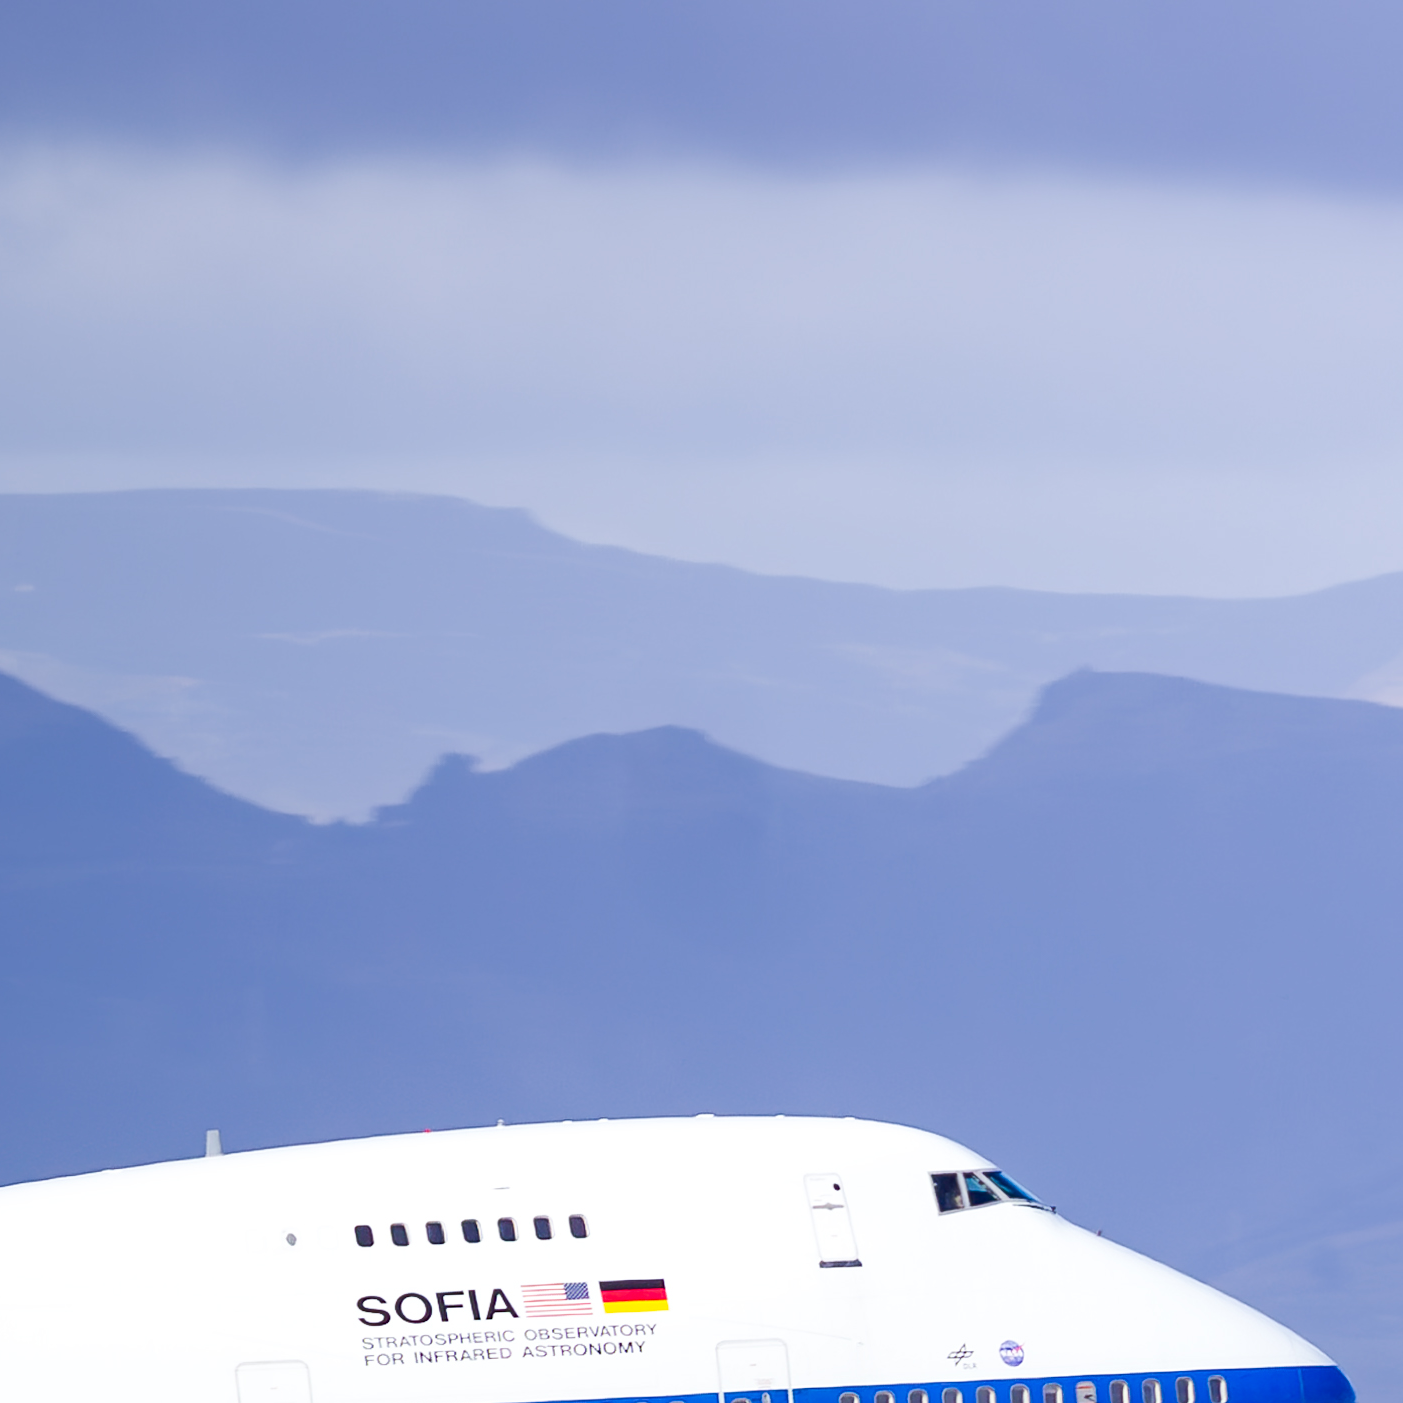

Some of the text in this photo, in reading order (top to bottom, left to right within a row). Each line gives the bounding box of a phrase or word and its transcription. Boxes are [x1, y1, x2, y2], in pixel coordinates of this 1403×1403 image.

[356, 1288, 520, 1327] SOFIA
[361, 1323, 658, 1350] STRATOSPHERIC OBSERVATORY
[364, 1340, 646, 1366] FOR INFRARED ASTRONOMY
